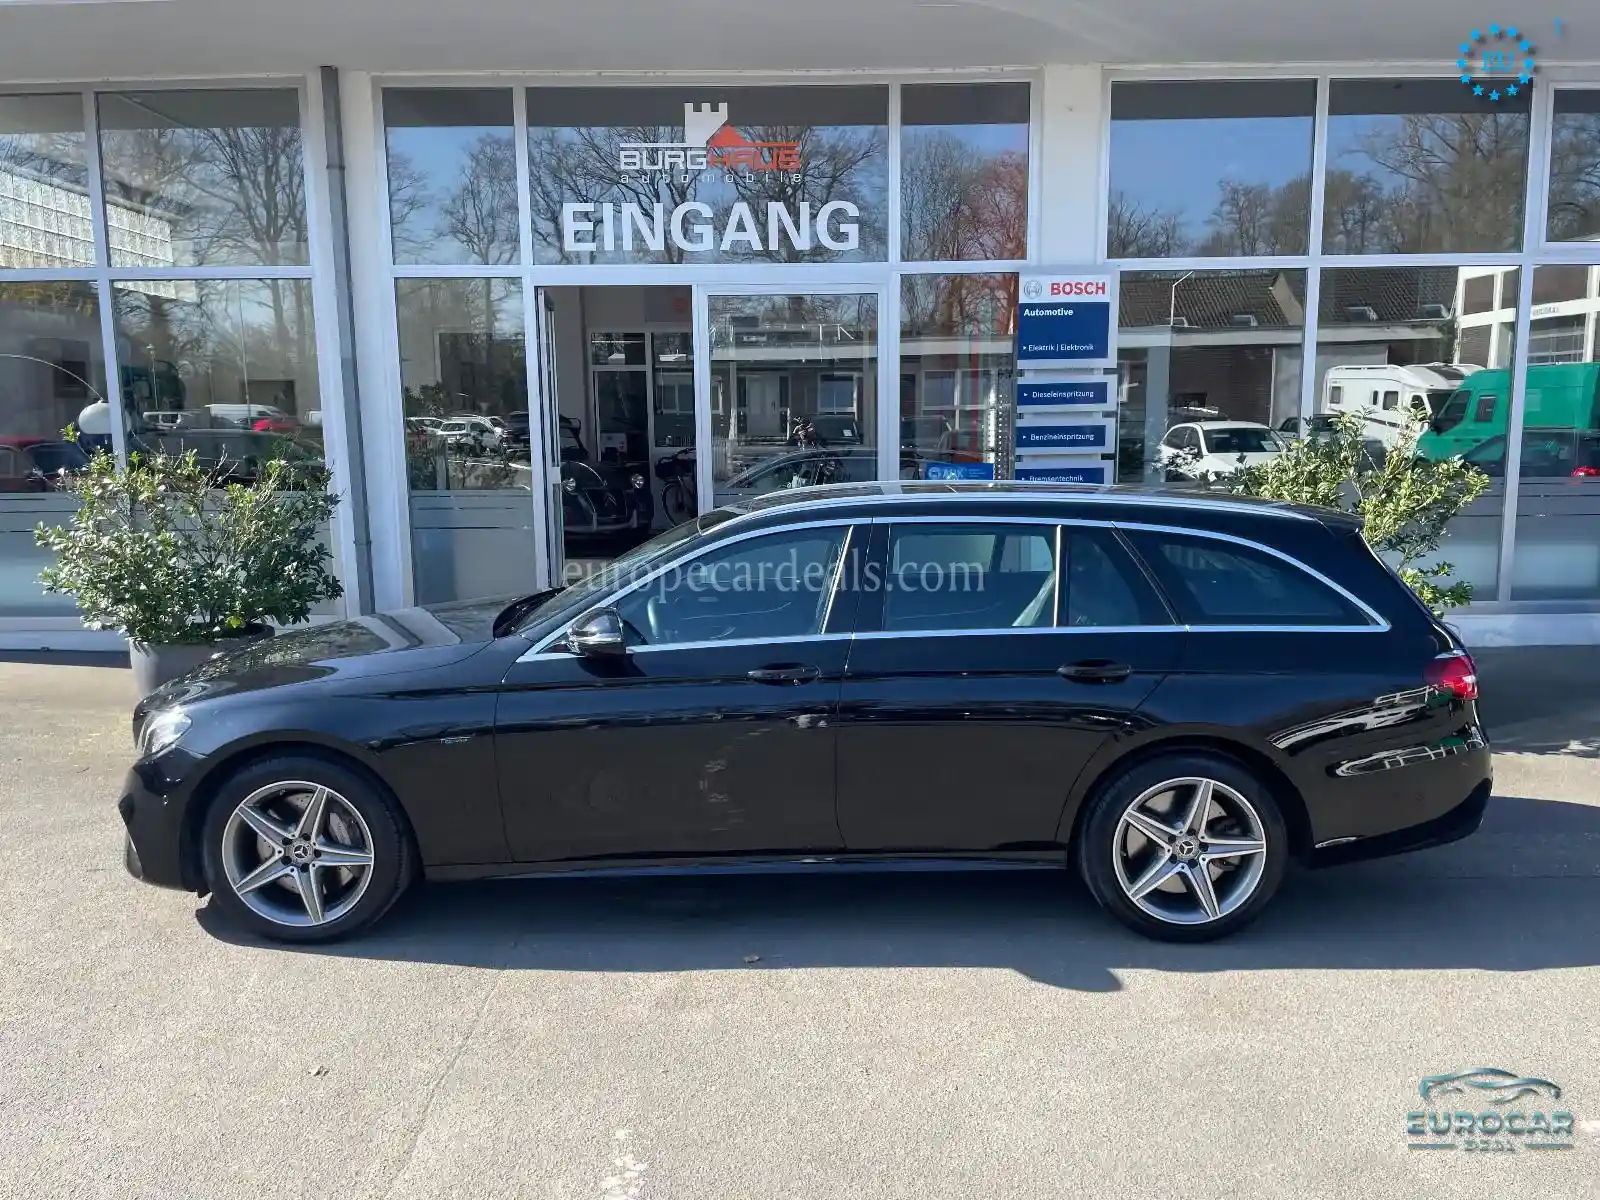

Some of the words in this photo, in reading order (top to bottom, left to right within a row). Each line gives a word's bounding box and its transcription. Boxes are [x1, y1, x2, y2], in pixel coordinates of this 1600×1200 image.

[620, 171, 802, 184] automobile
[562, 200, 860, 252] EINGANG
[1050, 281, 1106, 297] BOSCH
[1023, 307, 1075, 317] Automotive
[1028, 344, 1055, 352] Elektrik
[1060, 343, 1094, 352] Elektronik
[1032, 390, 1095, 399] Dieseleinspritzung
[1030, 433, 1095, 442] Benzineinspritzung
